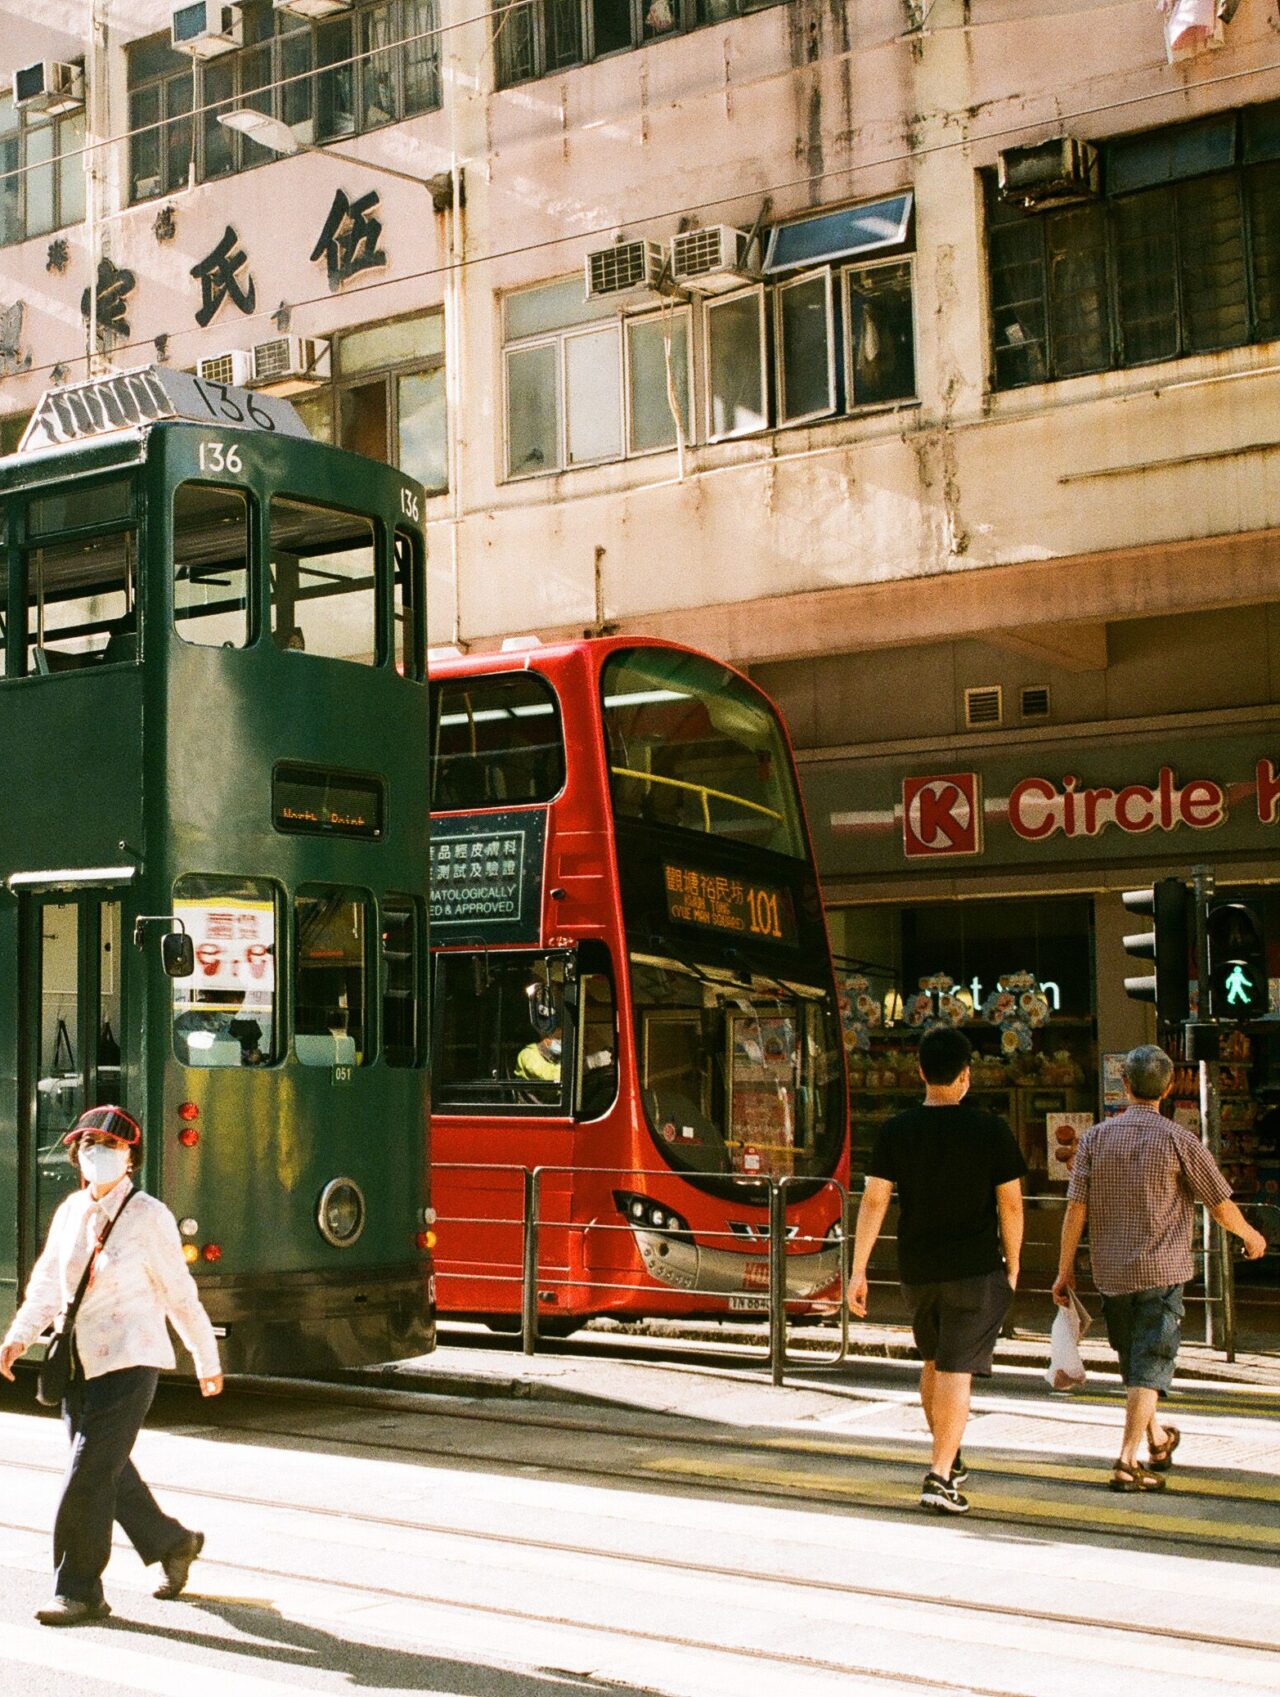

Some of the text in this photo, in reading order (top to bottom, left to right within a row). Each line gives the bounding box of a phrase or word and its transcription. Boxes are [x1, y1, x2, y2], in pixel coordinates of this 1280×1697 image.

[193, 379, 276, 431] 136
[199, 442, 243, 473] 136
[400, 487, 419, 522] 136
[1008, 765, 1223, 841] Circle
[430, 860, 516, 880] 測試及驗證
[445, 904, 452, 915] &
[454, 901, 515, 915] APPROVED
[747, 887, 783, 938] 101
[335, 1067, 352, 1081] 051
